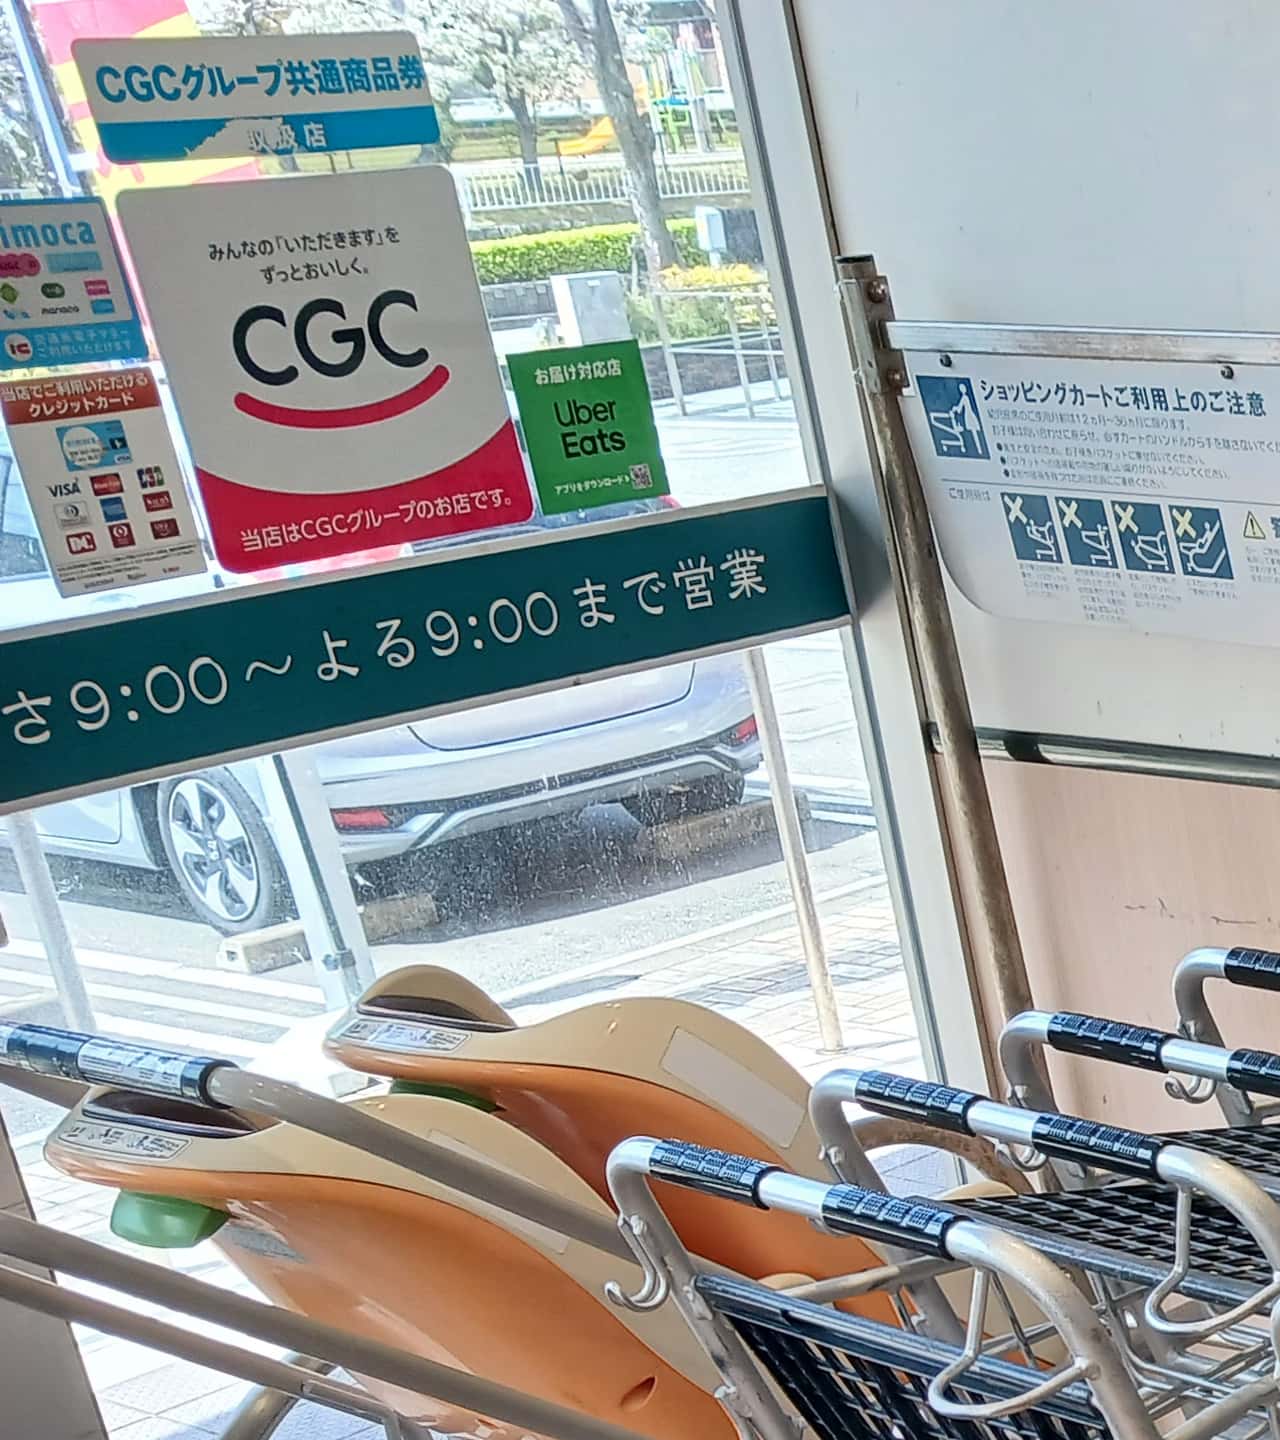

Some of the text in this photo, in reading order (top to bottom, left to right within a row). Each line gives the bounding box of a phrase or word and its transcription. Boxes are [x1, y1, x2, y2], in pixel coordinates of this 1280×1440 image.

[95, 54, 425, 102] CGCグループ共通商品券
[208, 225, 400, 262] みんなの「いただきます」を
[259, 257, 369, 285] ずっとおいしく。
[232, 290, 429, 386] CGC
[535, 359, 622, 386] お届け対応店
[29, 392, 135, 418] クレジットカード
[554, 397, 616, 428] Uber
[980, 379, 1267, 417] ショッピングカートご利用上のご注意
[562, 428, 626, 460] Eats
[48, 479, 82, 498] VISA
[240, 489, 512, 553] 当店はCGCグループのお店です。
